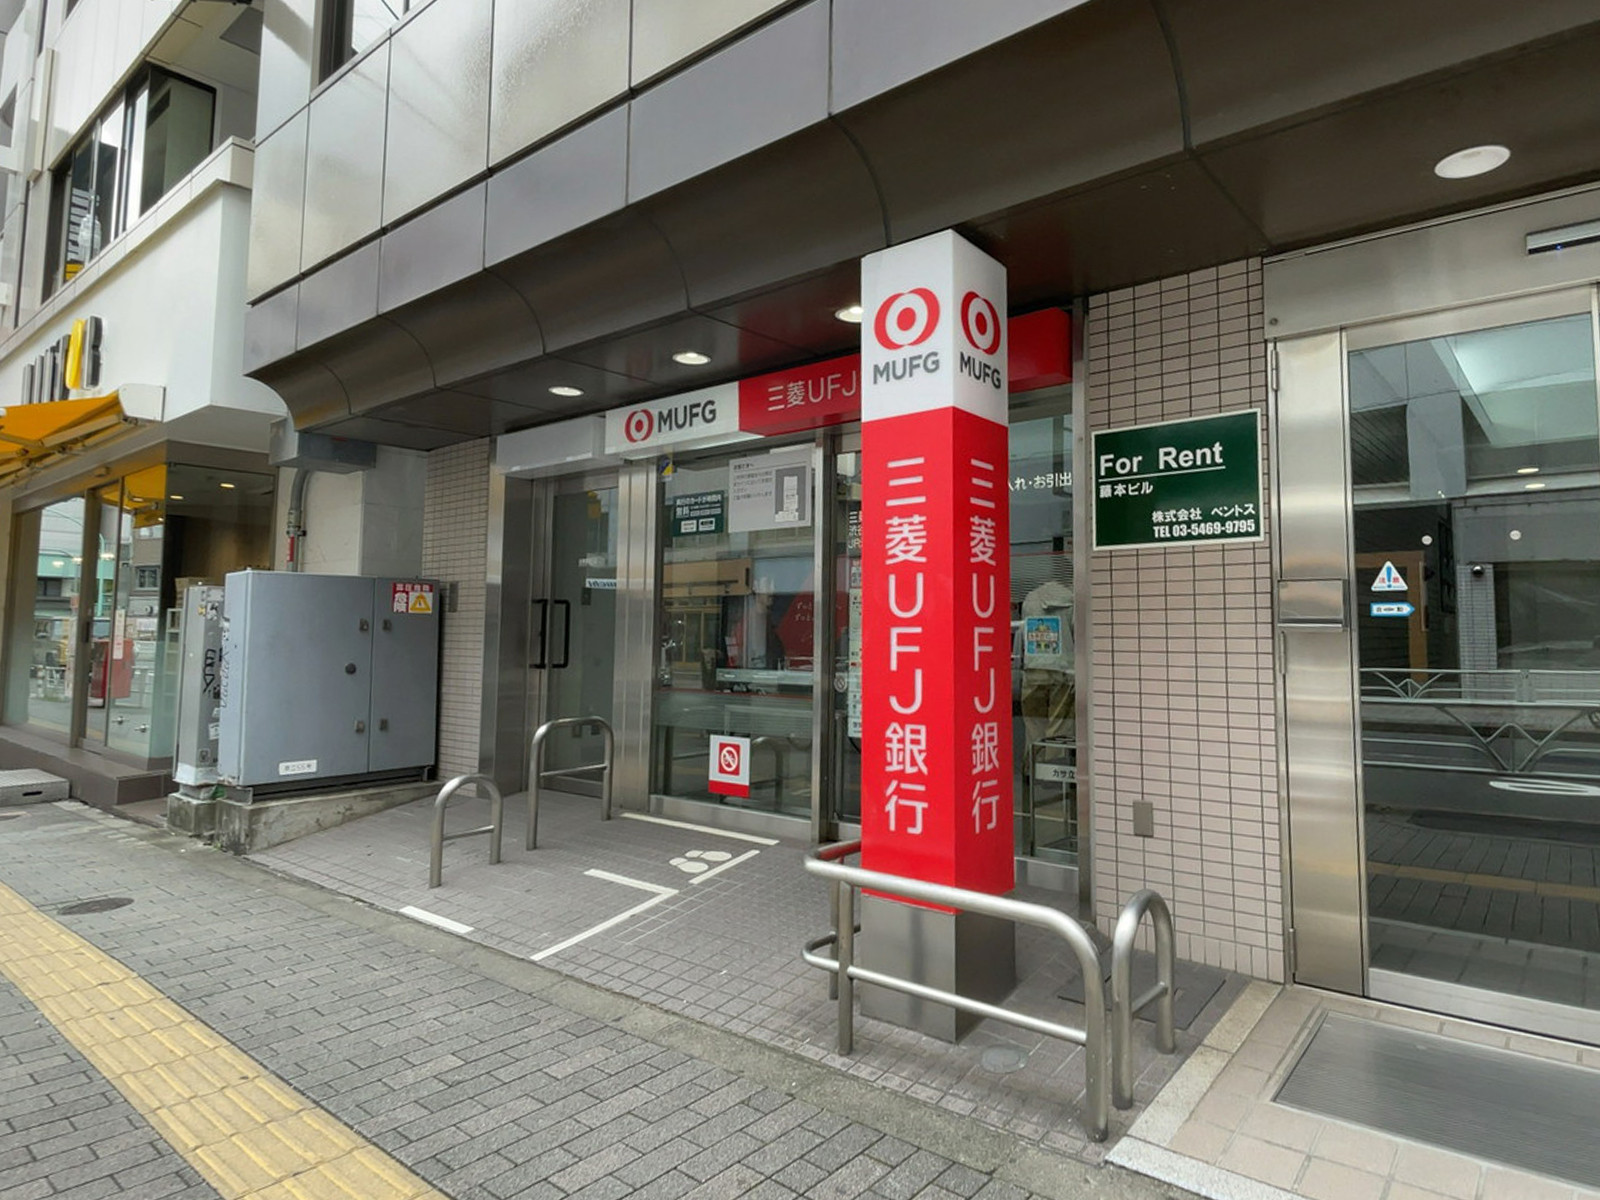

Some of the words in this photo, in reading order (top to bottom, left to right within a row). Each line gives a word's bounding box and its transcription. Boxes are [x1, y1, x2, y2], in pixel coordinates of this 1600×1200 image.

[873, 351, 940, 385] MUFG
[959, 351, 1002, 389] MUFG
[767, 373, 857, 412] 三菱UFJ
[657, 400, 717, 433] MUFG
[1100, 454, 1143, 476] For
[1158, 441, 1223, 469] Rent
[1152, 508, 1202, 523] 株式会社
[1153, 525, 1171, 538] TEL
[1172, 519, 1256, 537] 03-5469-9795
[885, 456, 929, 835] 三菱UFJ銀行
[969, 458, 1000, 835] 三菱UFJ銀行
